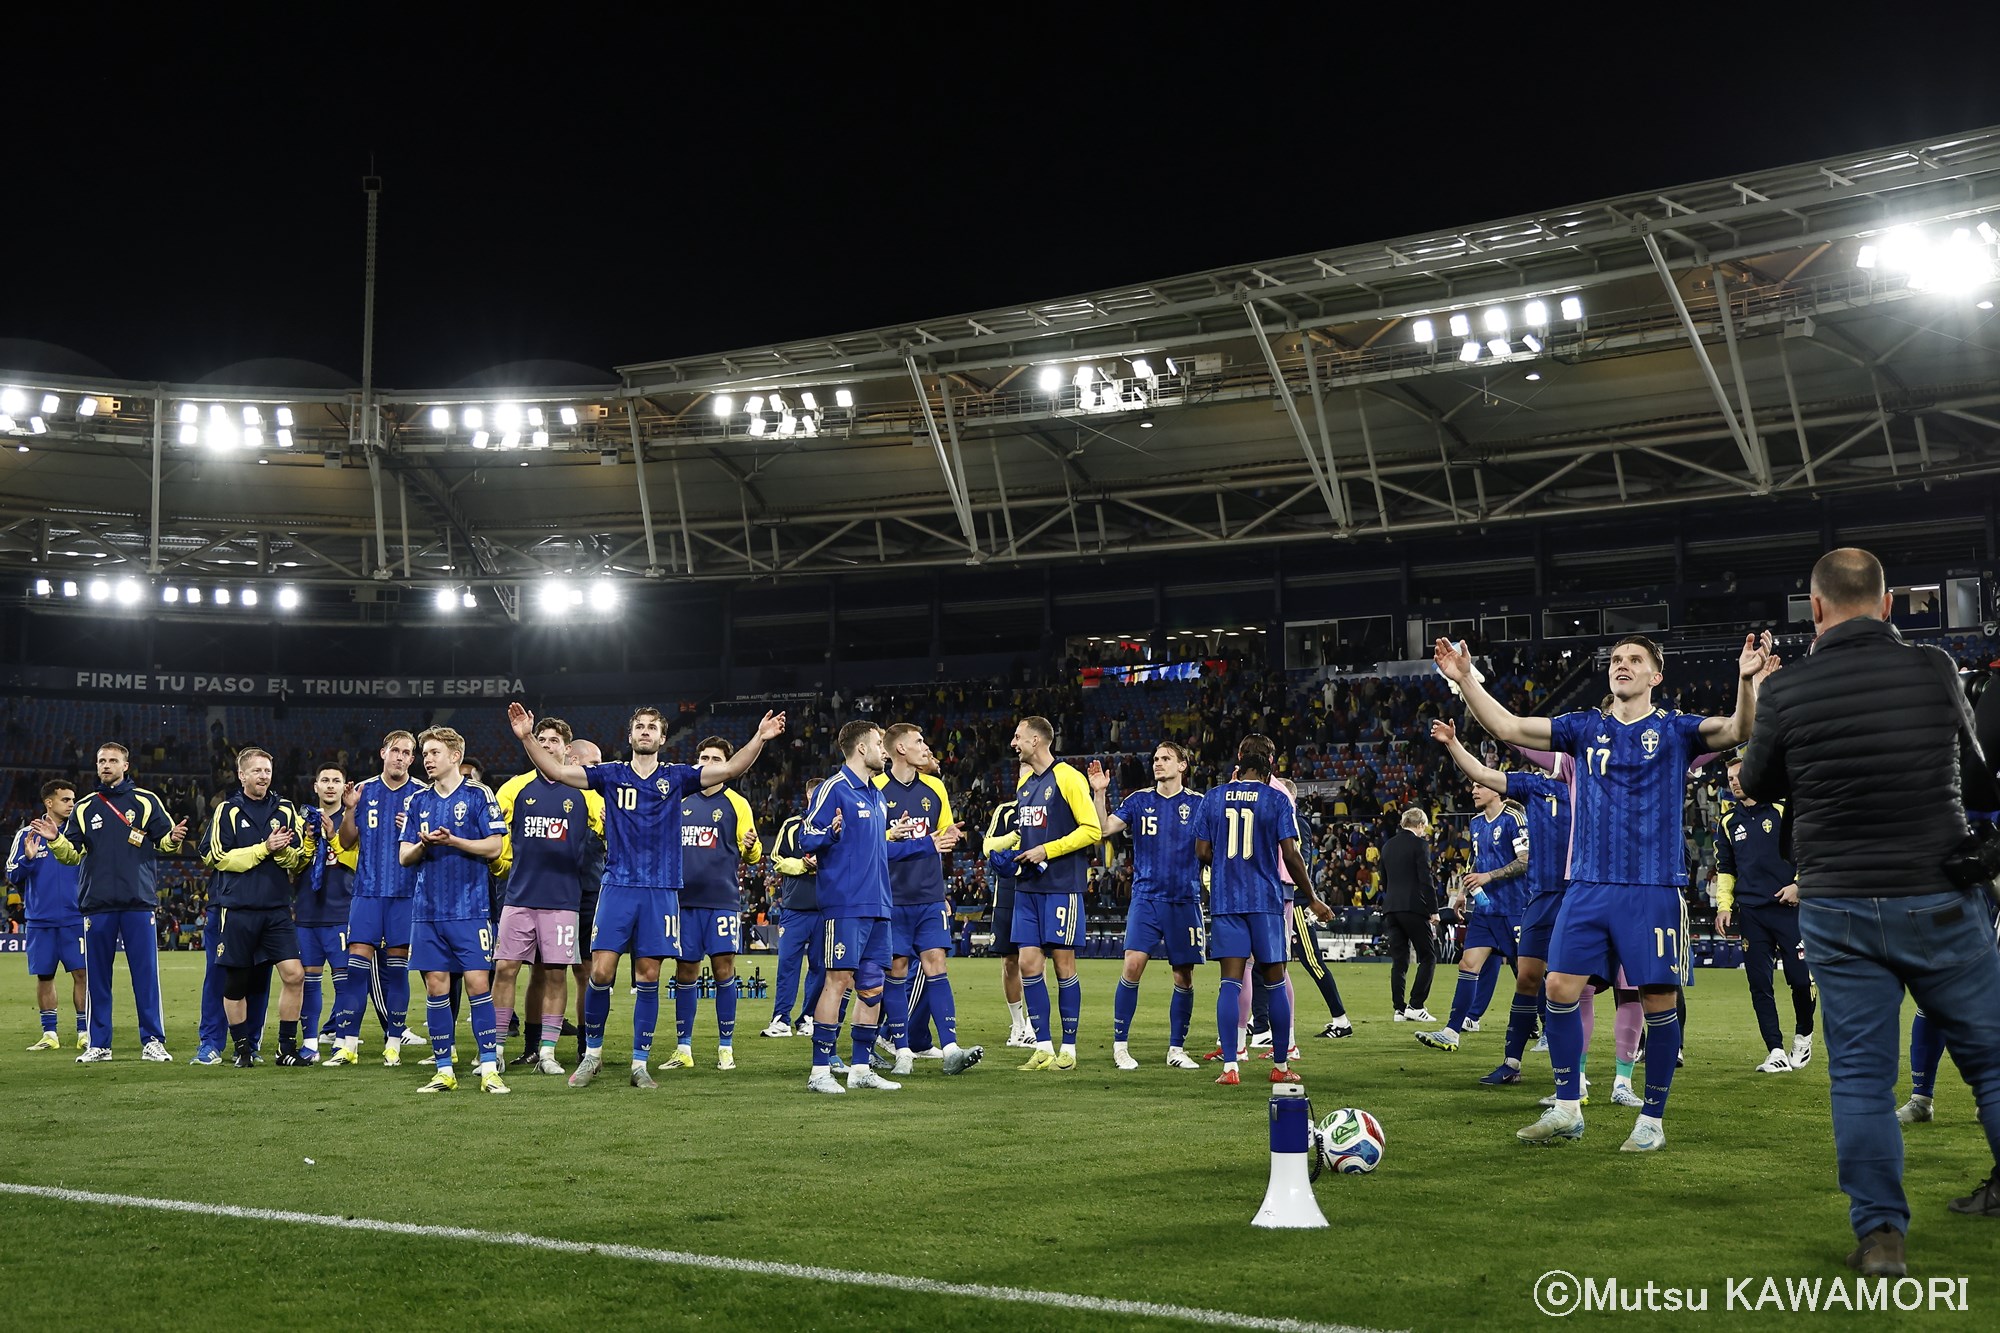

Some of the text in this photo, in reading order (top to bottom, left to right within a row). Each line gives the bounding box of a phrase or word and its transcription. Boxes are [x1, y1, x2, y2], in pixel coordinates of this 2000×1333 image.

[76, 671, 526, 695] FIRME TU PASO EL TRIUNFO TE ESPERA
[1586, 747, 1611, 776] 17
[616, 787, 637, 811] 10
[1225, 790, 1259, 802] ELANGA
[1545, 796, 1558, 817] 7
[367, 809, 378, 829] 6
[524, 816, 569, 829] SVENSKA
[1140, 816, 1158, 836] 15
[524, 827, 546, 838] SPEL
[1225, 807, 1255, 861] 11
[716, 915, 737, 937] 22
[1055, 906, 1067, 927] 9
[478, 928, 490, 951] 8
[556, 925, 574, 946] 12
[1188, 926, 1204, 947] 15
[478, 1028, 497, 1037] SVERIG
